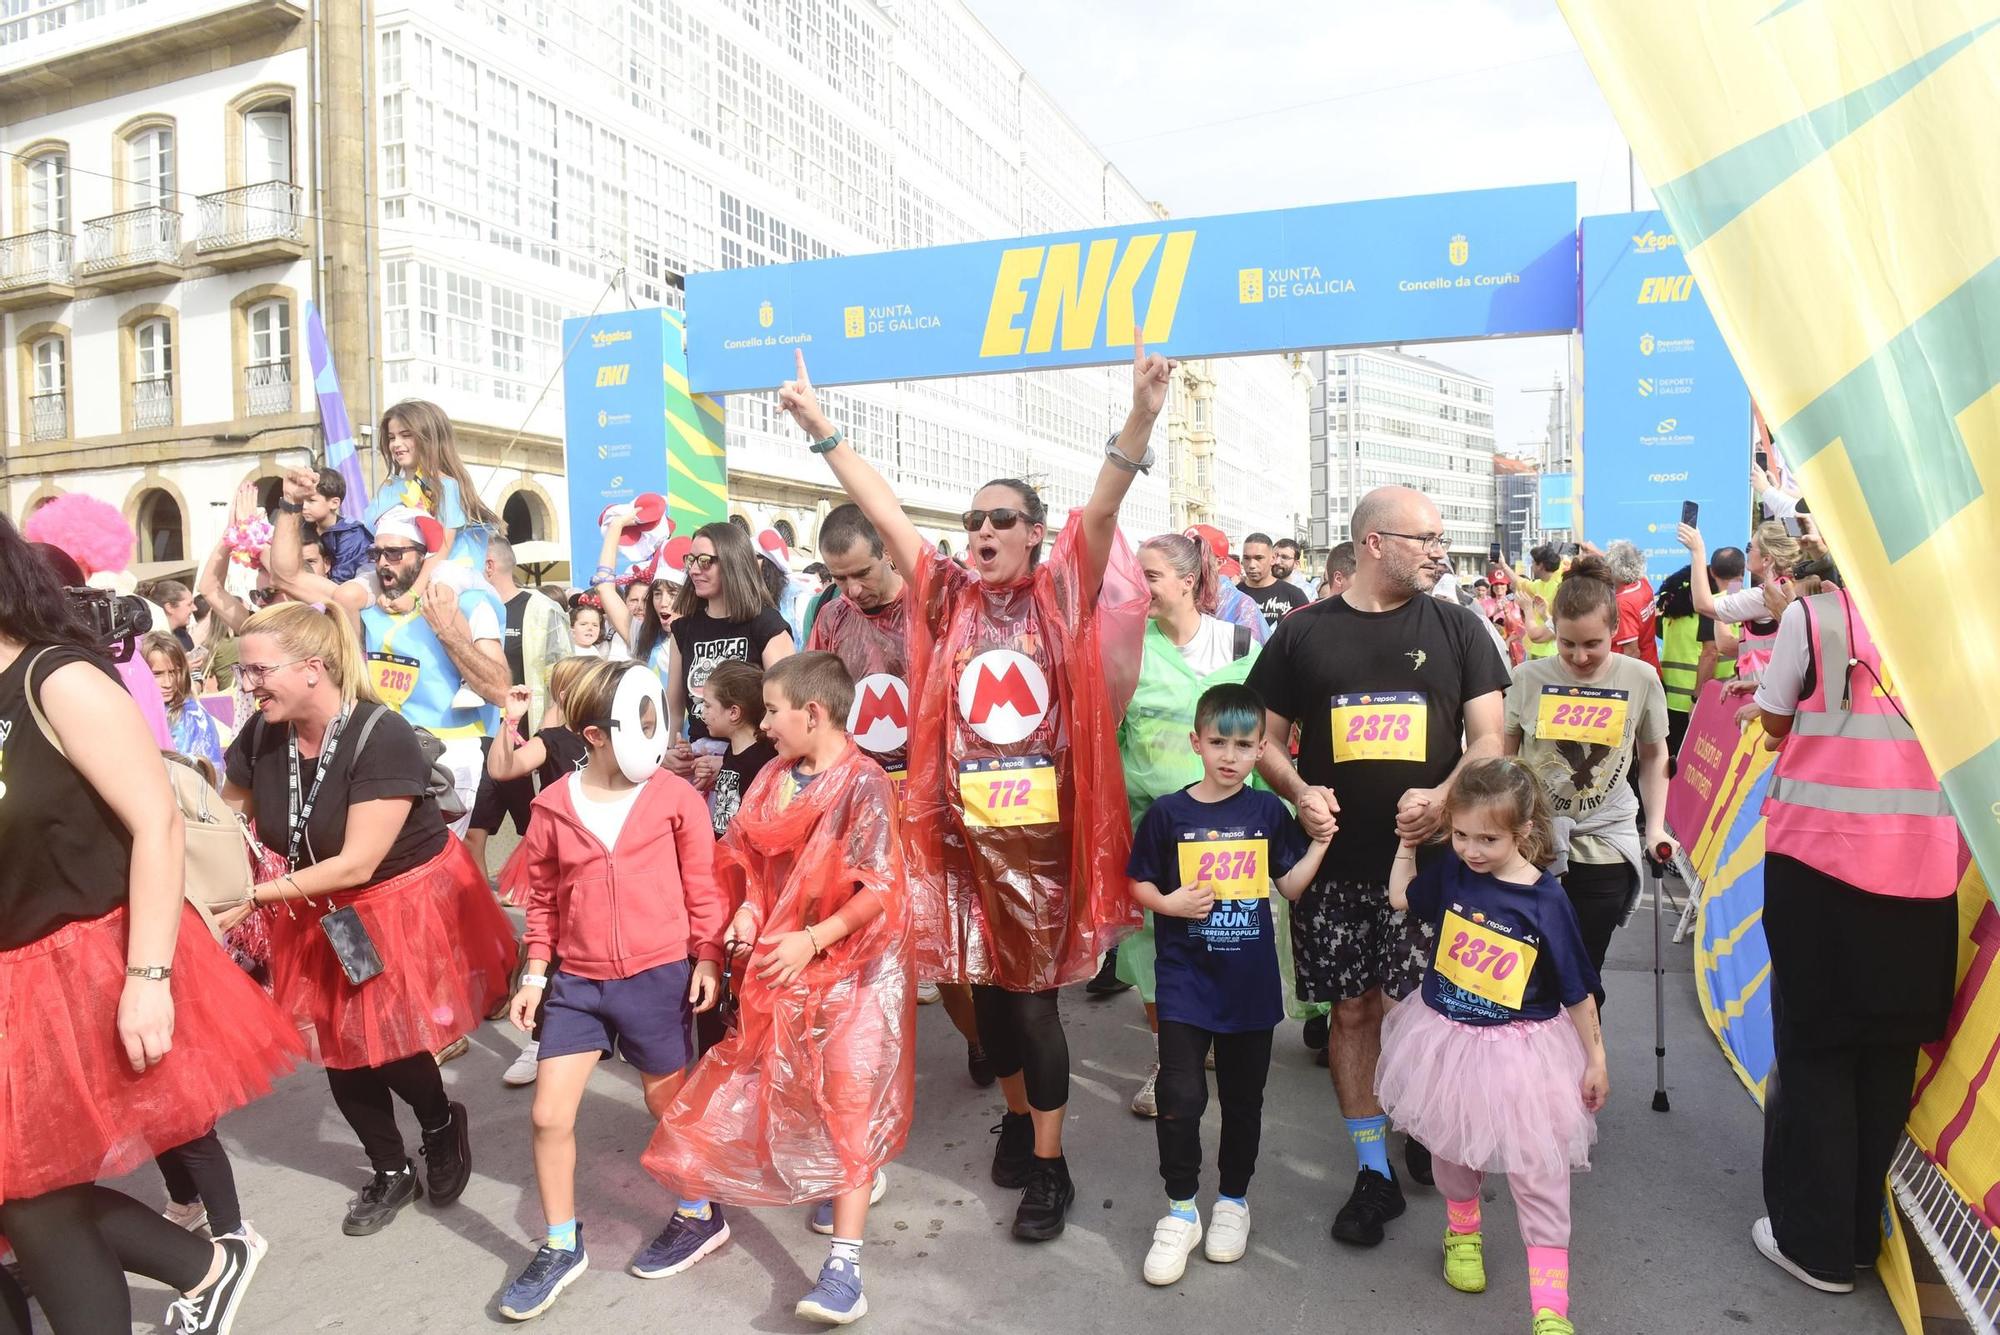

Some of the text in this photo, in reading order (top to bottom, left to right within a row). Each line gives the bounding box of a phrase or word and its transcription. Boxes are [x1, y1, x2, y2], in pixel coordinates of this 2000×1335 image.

[1268, 266, 1321, 282] XUNTA
[1399, 271, 1520, 292] Concello da Coruña
[979, 230, 1197, 358] ENKI
[1268, 279, 1356, 298] DE GALICIA
[1637, 274, 1696, 304] ENKI
[869, 304, 912, 318] XUNTA
[869, 316, 941, 333] DE GALICIA
[724, 332, 812, 349] Concello da Coruña
[595, 364, 630, 388] ENKI
[1648, 470, 1688, 483] repsol
[380, 669, 412, 692] 2783
[969, 661, 1041, 724] M
[1373, 695, 1397, 703] repsol
[854, 682, 907, 735] M
[1552, 704, 1613, 729] 2372
[1346, 714, 1411, 743] 2373
[1001, 760, 1024, 769] repsol
[987, 778, 1031, 809] 772
[1221, 830, 1244, 838] repsol
[1198, 850, 1256, 881] 2374
[1230, 928, 1260, 936] POPULAR
[1486, 919, 1512, 933] repsol
[1448, 931, 1518, 981] 2370
